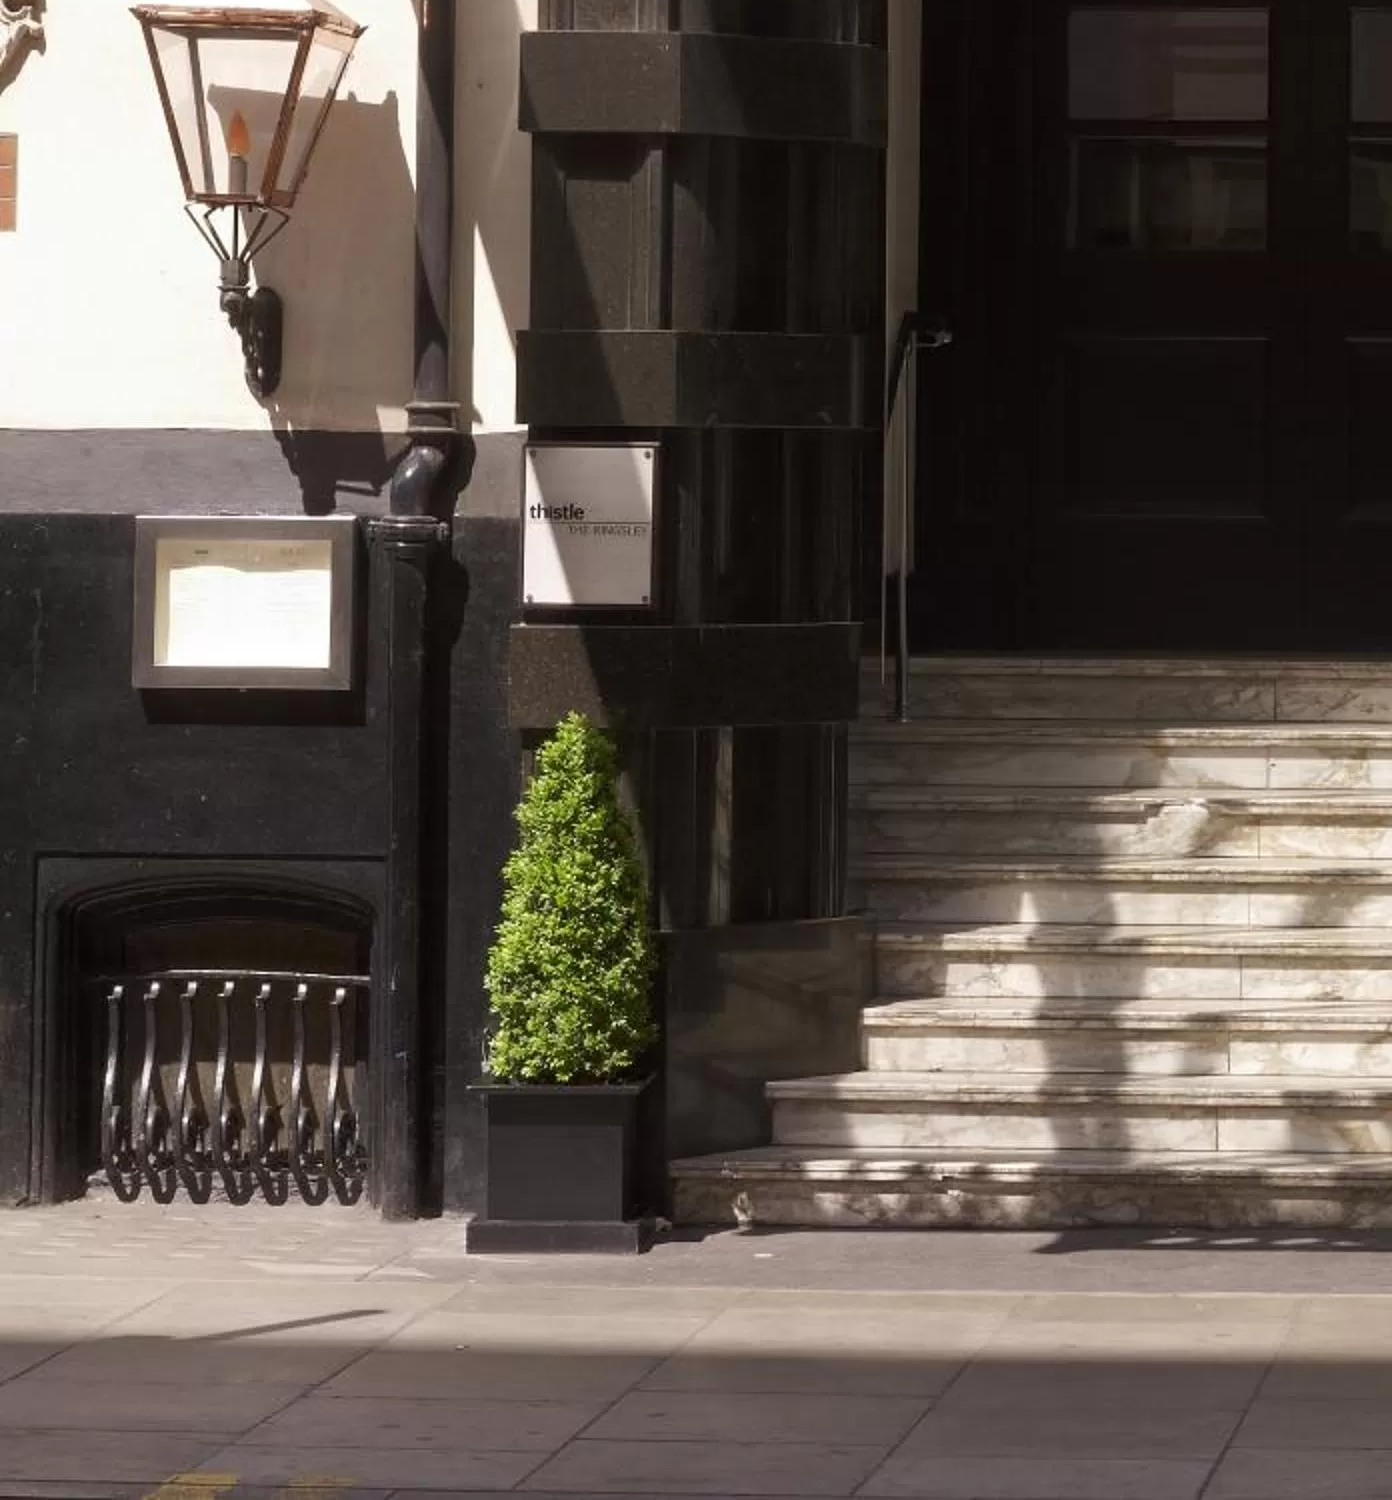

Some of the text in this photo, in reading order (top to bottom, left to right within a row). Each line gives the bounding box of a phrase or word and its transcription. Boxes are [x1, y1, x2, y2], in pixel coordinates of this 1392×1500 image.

[529, 503, 585, 520] thistle
[569, 525, 647, 537] THE KINGSLEY
